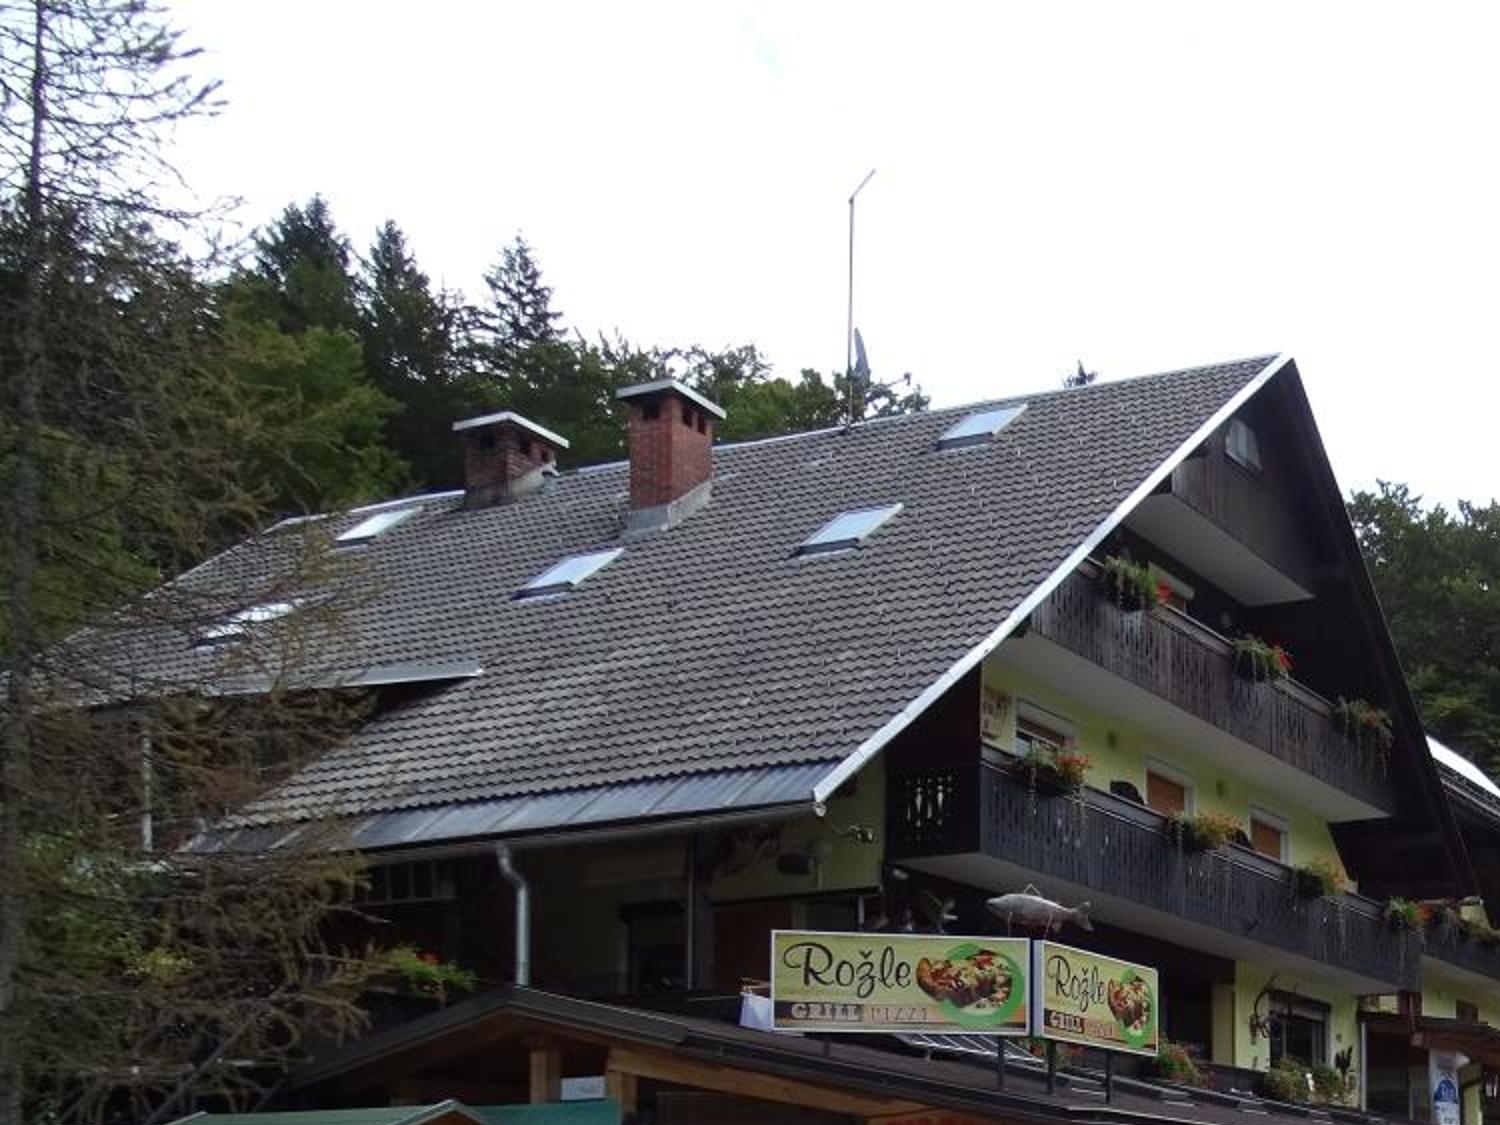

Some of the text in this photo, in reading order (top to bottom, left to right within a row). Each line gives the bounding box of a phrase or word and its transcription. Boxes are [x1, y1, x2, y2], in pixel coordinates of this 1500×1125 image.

[783, 942, 911, 999] Rožle
[1047, 955, 1105, 1012] Rožle
[791, 1003, 859, 1020] GRILL
